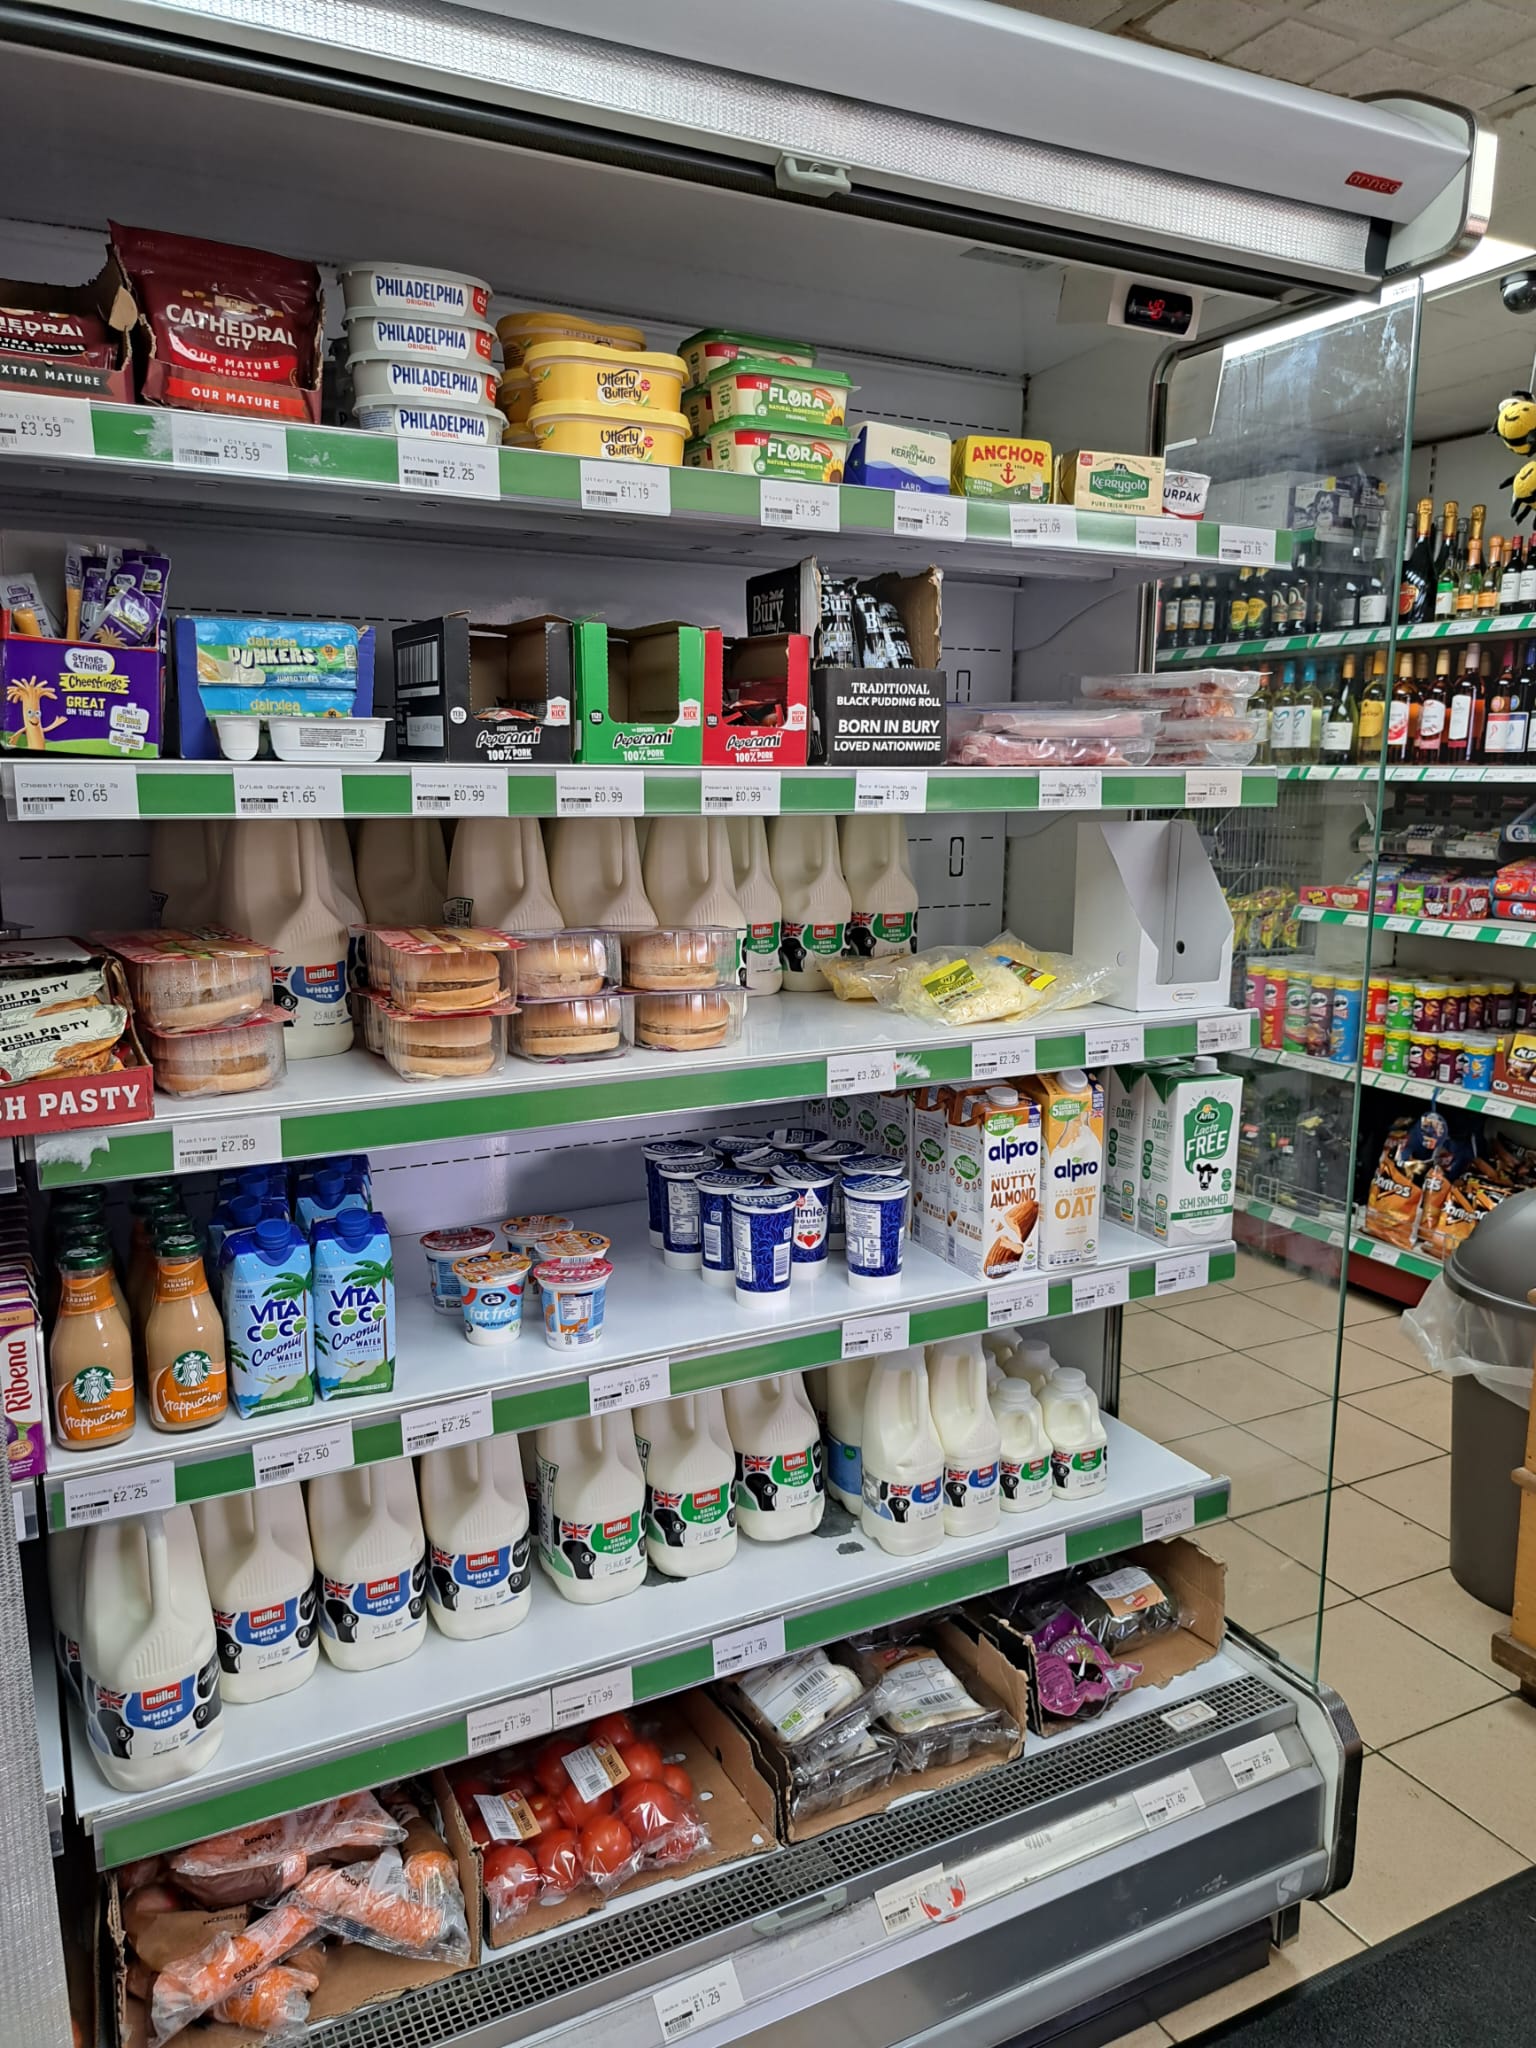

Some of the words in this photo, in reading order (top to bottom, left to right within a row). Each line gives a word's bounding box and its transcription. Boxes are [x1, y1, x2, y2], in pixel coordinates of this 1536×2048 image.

[376, 275, 465, 307] PHILADELPHIA
[406, 298, 436, 308] ORIGINAL
[165, 303, 297, 349] CATHEDRAL
[215, 335, 251, 351] CITY
[377, 321, 467, 350] PHILADELPHIA
[407, 343, 437, 352] ORIGINAL
[188, 348, 217, 365] OUR
[225, 359, 280, 370] MATURE
[0, 364, 38, 378] XTRA
[45, 369, 100, 386] MATURE
[210, 366, 260, 378] CHEDDAR
[391, 364, 478, 394] PHILADELPHIA
[597, 371, 636, 389] Utterly
[191, 386, 219, 400] OUR
[226, 393, 280, 410] MATURE
[422, 386, 452, 396] ORIGINAL
[602, 386, 643, 402] Butterly
[768, 386, 825, 410] FLORA
[20, 420, 62, 438] £3.59
[399, 409, 486, 437] PHILADELPHIA
[430, 431, 459, 440] ORIGINAL
[600, 429, 639, 446] Utterly
[223, 445, 261, 461] £3.59
[605, 443, 645, 459] Butterly
[767, 442, 823, 463] FLORA
[891, 446, 936, 465] KERRYMAID
[971, 444, 1046, 467] ANCHOR
[442, 466, 475, 481] £2.25
[620, 486, 650, 500] £1.19
[900, 480, 921, 492] LARD
[1163, 488, 1201, 504] URPAK
[795, 503, 821, 517] £1.95
[1124, 503, 1146, 511] BUTTER
[925, 513, 949, 527] £1.25
[752, 595, 784, 625] Bury
[247, 637, 297, 648] dairylea
[72, 653, 104, 664] Strings
[228, 646, 316, 669] DUNKERS
[73, 661, 108, 672] &Things
[68, 674, 122, 691] Cheestrings
[851, 682, 930, 695] TRADITIONAL
[66, 696, 106, 709] GREAT
[250, 698, 301, 713] dairylea
[836, 696, 870, 706] BLACK
[871, 696, 916, 707] PUDDING
[918, 697, 941, 707] ROLL
[66, 708, 77, 716] ON
[551, 709, 566, 717] KICK
[683, 710, 697, 718] KICK
[838, 719, 882, 734] BORN
[883, 719, 898, 734] IN
[902, 719, 940, 734] BURY
[475, 726, 542, 749] Peperami
[612, 728, 674, 748] Peperami
[725, 733, 783, 751] Peperami
[834, 740, 870, 751] LOVED
[871, 740, 941, 751] NATIONWIDE
[486, 750, 512, 761] 100%
[512, 748, 532, 758] PORK
[622, 750, 646, 761] 100%
[647, 749, 665, 758] PORK
[735, 752, 757, 763] 100%
[756, 751, 774, 760] PORK
[69, 789, 108, 802] £0.65
[282, 791, 317, 803] £1.65
[454, 789, 485, 802] £0.99
[594, 791, 623, 803] £0.99
[735, 791, 761, 802] £0.99
[886, 789, 910, 801] £1.39
[308, 968, 335, 980] müller
[21, 980, 69, 999] PASTY
[305, 985, 340, 994] WHOLE
[40, 1018, 90, 1037] PASTY
[6, 1034, 54, 1050] ORIGINAL
[1110, 1041, 1131, 1053] £2.29
[1000, 1053, 1021, 1065] £2.29
[857, 1069, 880, 1082] £3.20
[38, 1084, 140, 1118] PASTY
[1052, 1105, 1059, 1117] 5
[1116, 1107, 1135, 1120] DAIRY
[1198, 1110, 1215, 1121] Arla
[1151, 1118, 1170, 1130] DAIRY
[1193, 1123, 1219, 1136] Lacto
[221, 1138, 256, 1153] £2.89
[988, 1136, 1039, 1164] alpro
[1185, 1130, 1228, 1161] FREE
[1054, 1159, 1098, 1181] alpro
[990, 1172, 1036, 1192] NUTTY
[990, 1186, 1036, 1209] ALMOND
[1179, 1198, 1196, 1210] SEMI
[1196, 1194, 1229, 1207] SKIMMED
[1054, 1194, 1096, 1220] OAT
[163, 1280, 195, 1288] CARAMEL
[1097, 1286, 1116, 1298] £2.45
[65, 1295, 97, 1303] CARAMEL
[330, 1285, 381, 1309] VITA
[249, 1299, 301, 1324] VITA
[327, 1303, 386, 1327] COCO
[468, 1306, 491, 1321] fat
[490, 1304, 518, 1321] free
[246, 1316, 307, 1342] COCO
[331, 1318, 382, 1350] Coconut
[870, 1331, 893, 1343] £1.95
[251, 1330, 304, 1367] Coconut
[356, 1338, 382, 1348] WATER
[276, 1351, 303, 1363] WATER
[4, 1340, 31, 1415] Ribena
[624, 1380, 650, 1395] £0.69
[161, 1388, 223, 1414] frappuccino
[64, 1406, 128, 1431] frappuccino
[442, 1417, 471, 1433] £2.25
[297, 1447, 330, 1464] £2.50
[785, 1454, 807, 1467] müller
[113, 1486, 149, 1503] £2.25
[695, 1492, 720, 1505] müller
[606, 1520, 630, 1534] müller
[470, 1554, 496, 1567] müller
[466, 1568, 500, 1581] WHOLE
[369, 1579, 396, 1594] müller
[366, 1595, 401, 1610] WHOLE
[253, 1609, 282, 1624] müller
[250, 1623, 287, 1639] WHOLE
[743, 1640, 768, 1656] £1.49
[146, 1688, 178, 1705] müller
[586, 1690, 613, 1706] £1.99
[142, 1703, 183, 1723] WHOLE
[504, 1715, 532, 1733] £1.99
[1252, 1754, 1272, 1770] £2.99
[1165, 1792, 1186, 1809] £1.49
[694, 1990, 721, 2013] £1.29
